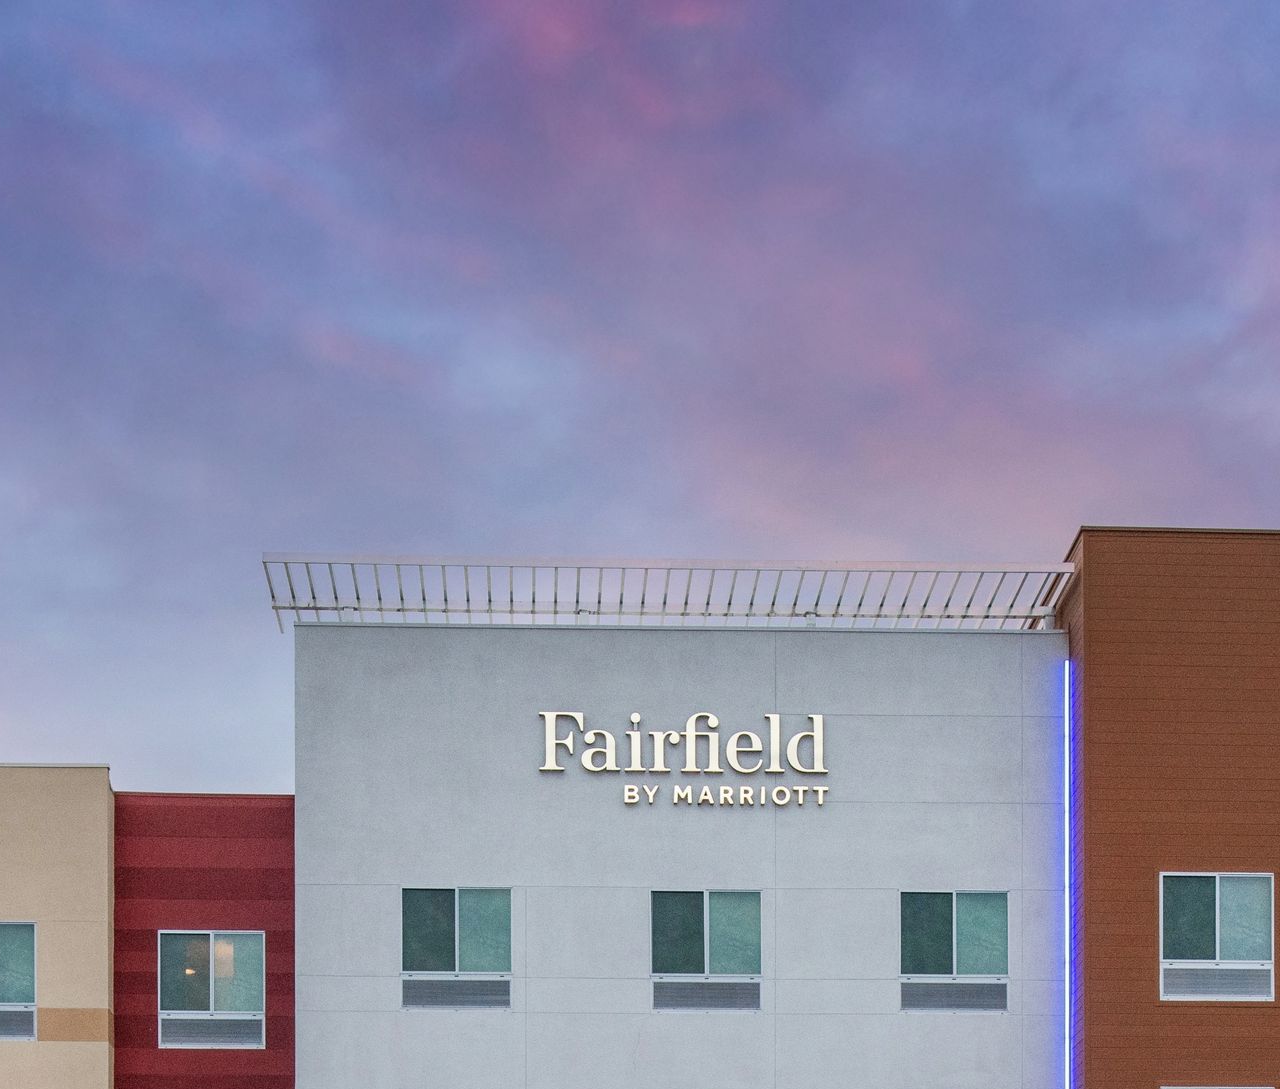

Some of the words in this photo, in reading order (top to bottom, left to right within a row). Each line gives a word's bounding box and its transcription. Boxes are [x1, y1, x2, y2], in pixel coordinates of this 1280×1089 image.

[538, 711, 829, 774] Fairfield
[623, 784, 660, 804] BY
[673, 785, 829, 806] MARRIOTT
